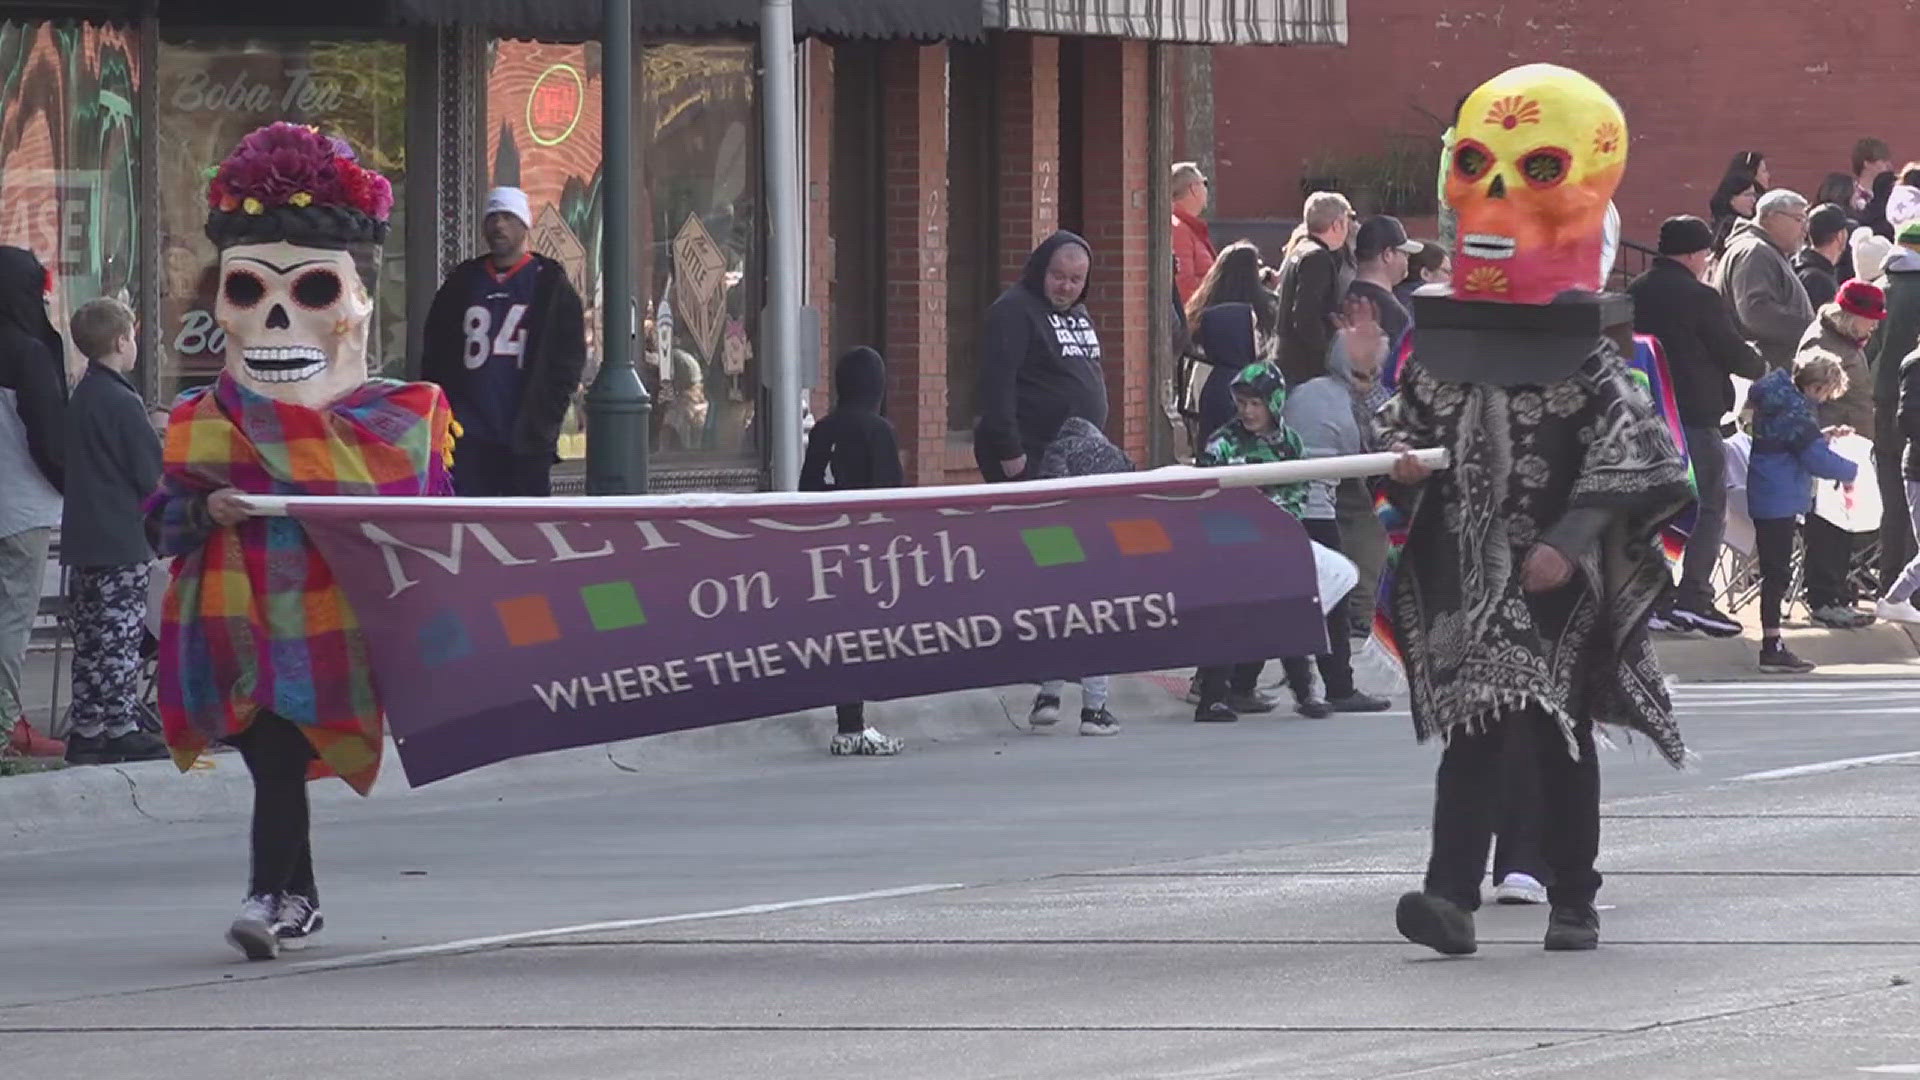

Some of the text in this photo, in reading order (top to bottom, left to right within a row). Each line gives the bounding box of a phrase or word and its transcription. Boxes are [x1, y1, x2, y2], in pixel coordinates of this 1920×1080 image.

[171, 68, 343, 112] Boba Tea
[0, 199, 87, 263] ASE
[463, 304, 529, 369] 84
[688, 570, 779, 619] on
[803, 529, 986, 609] Fifth
[532, 591, 1179, 713] WHERE THE WEEKEND STARTS!
